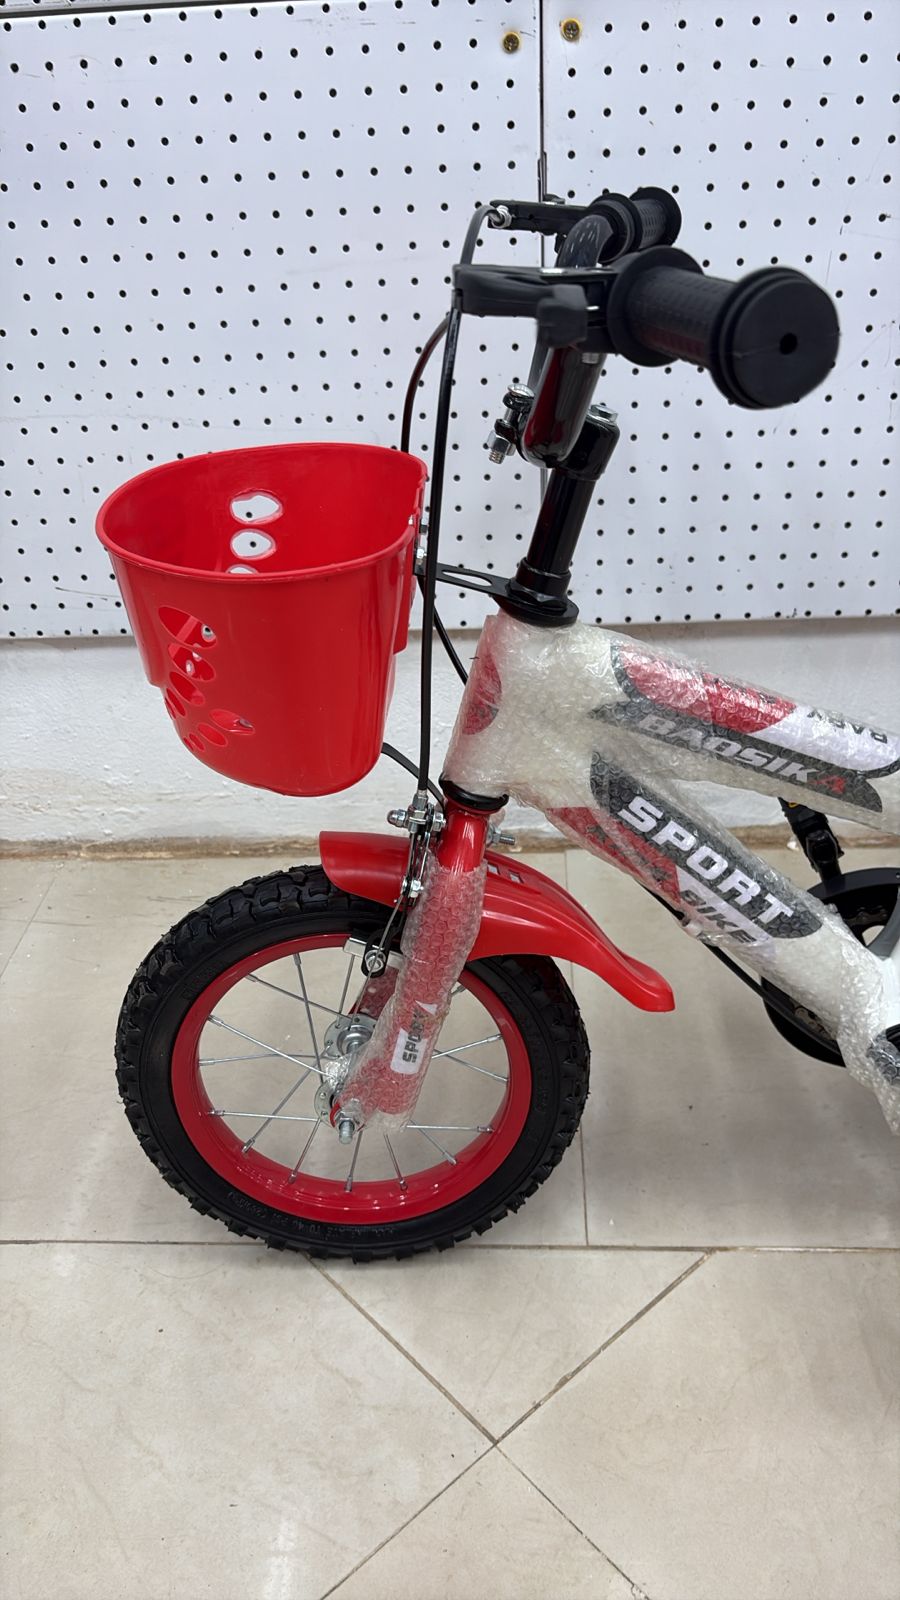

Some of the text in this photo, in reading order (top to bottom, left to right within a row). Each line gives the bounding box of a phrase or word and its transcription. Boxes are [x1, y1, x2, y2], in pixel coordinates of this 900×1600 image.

[637, 714, 846, 794] BAOSIKA
[617, 795, 794, 923] SPORT
[679, 889, 758, 945] BIKE
